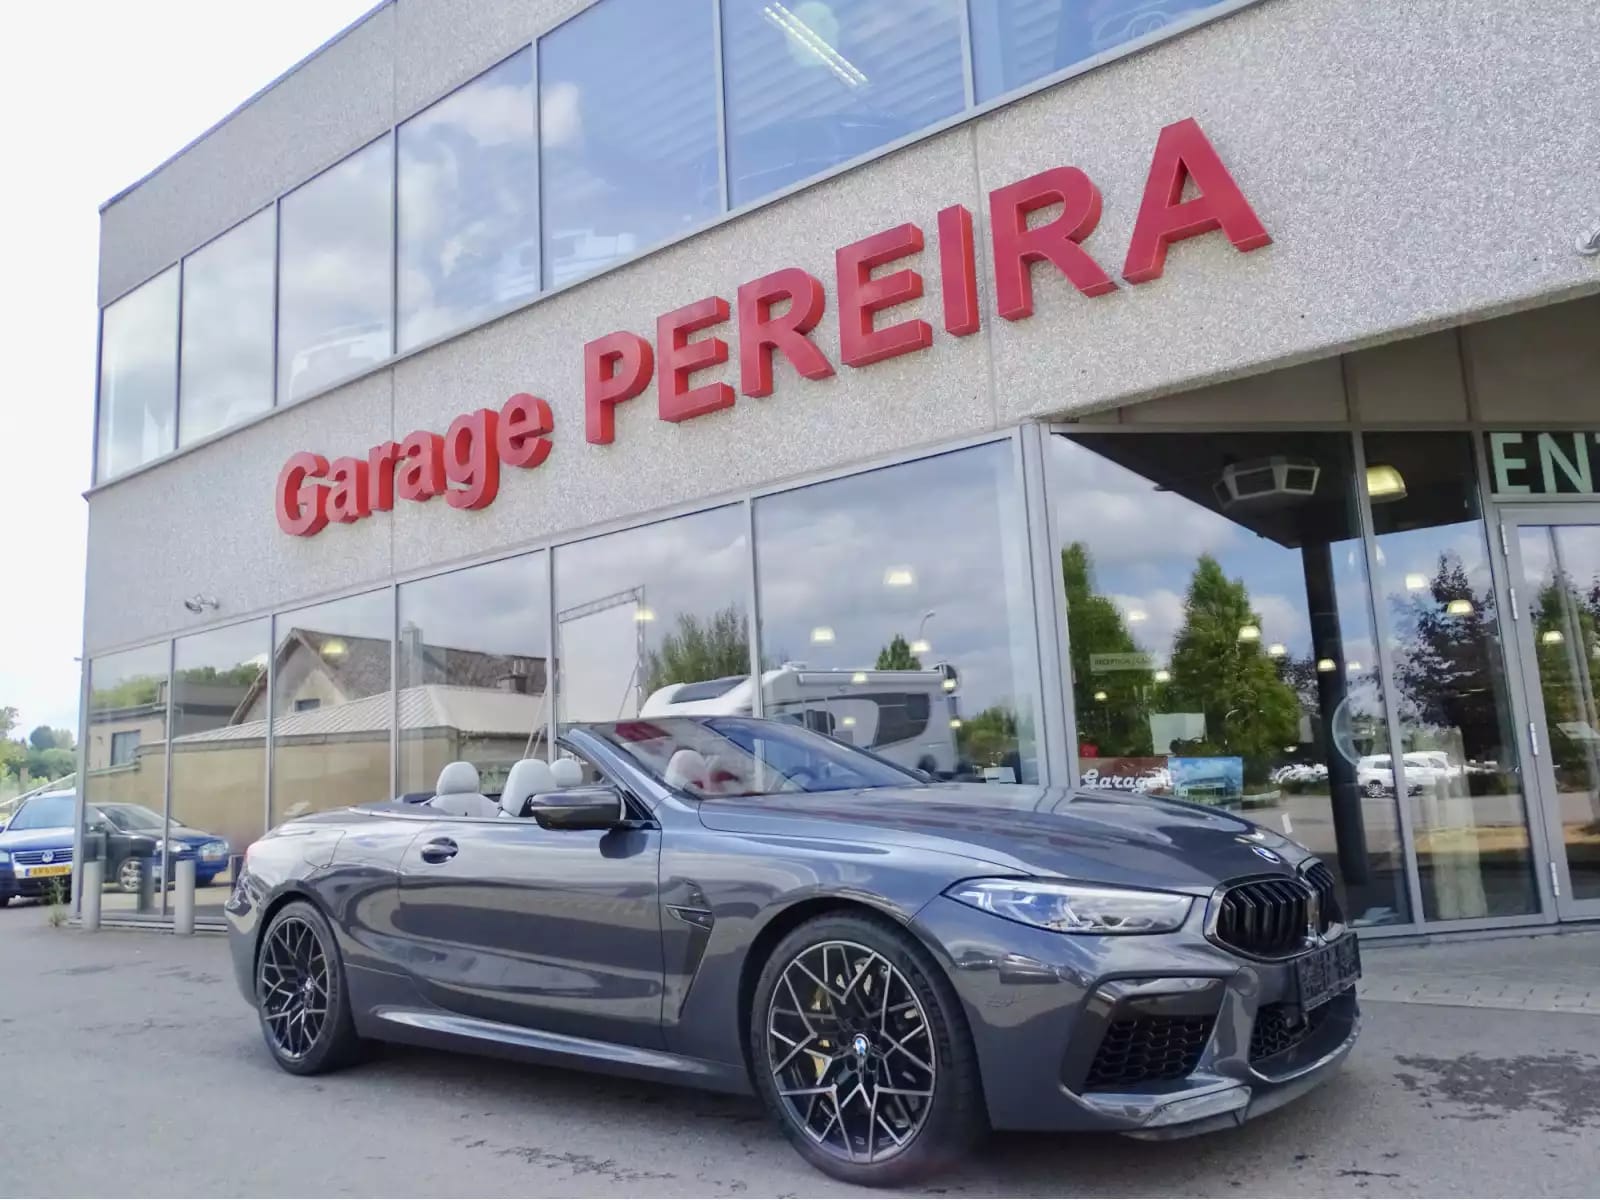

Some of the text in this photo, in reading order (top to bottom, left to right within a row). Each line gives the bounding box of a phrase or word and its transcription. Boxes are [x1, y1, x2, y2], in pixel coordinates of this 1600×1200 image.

[277, 118, 1271, 537] Garage PEREIRA
[1490, 432, 1600, 494] EN
